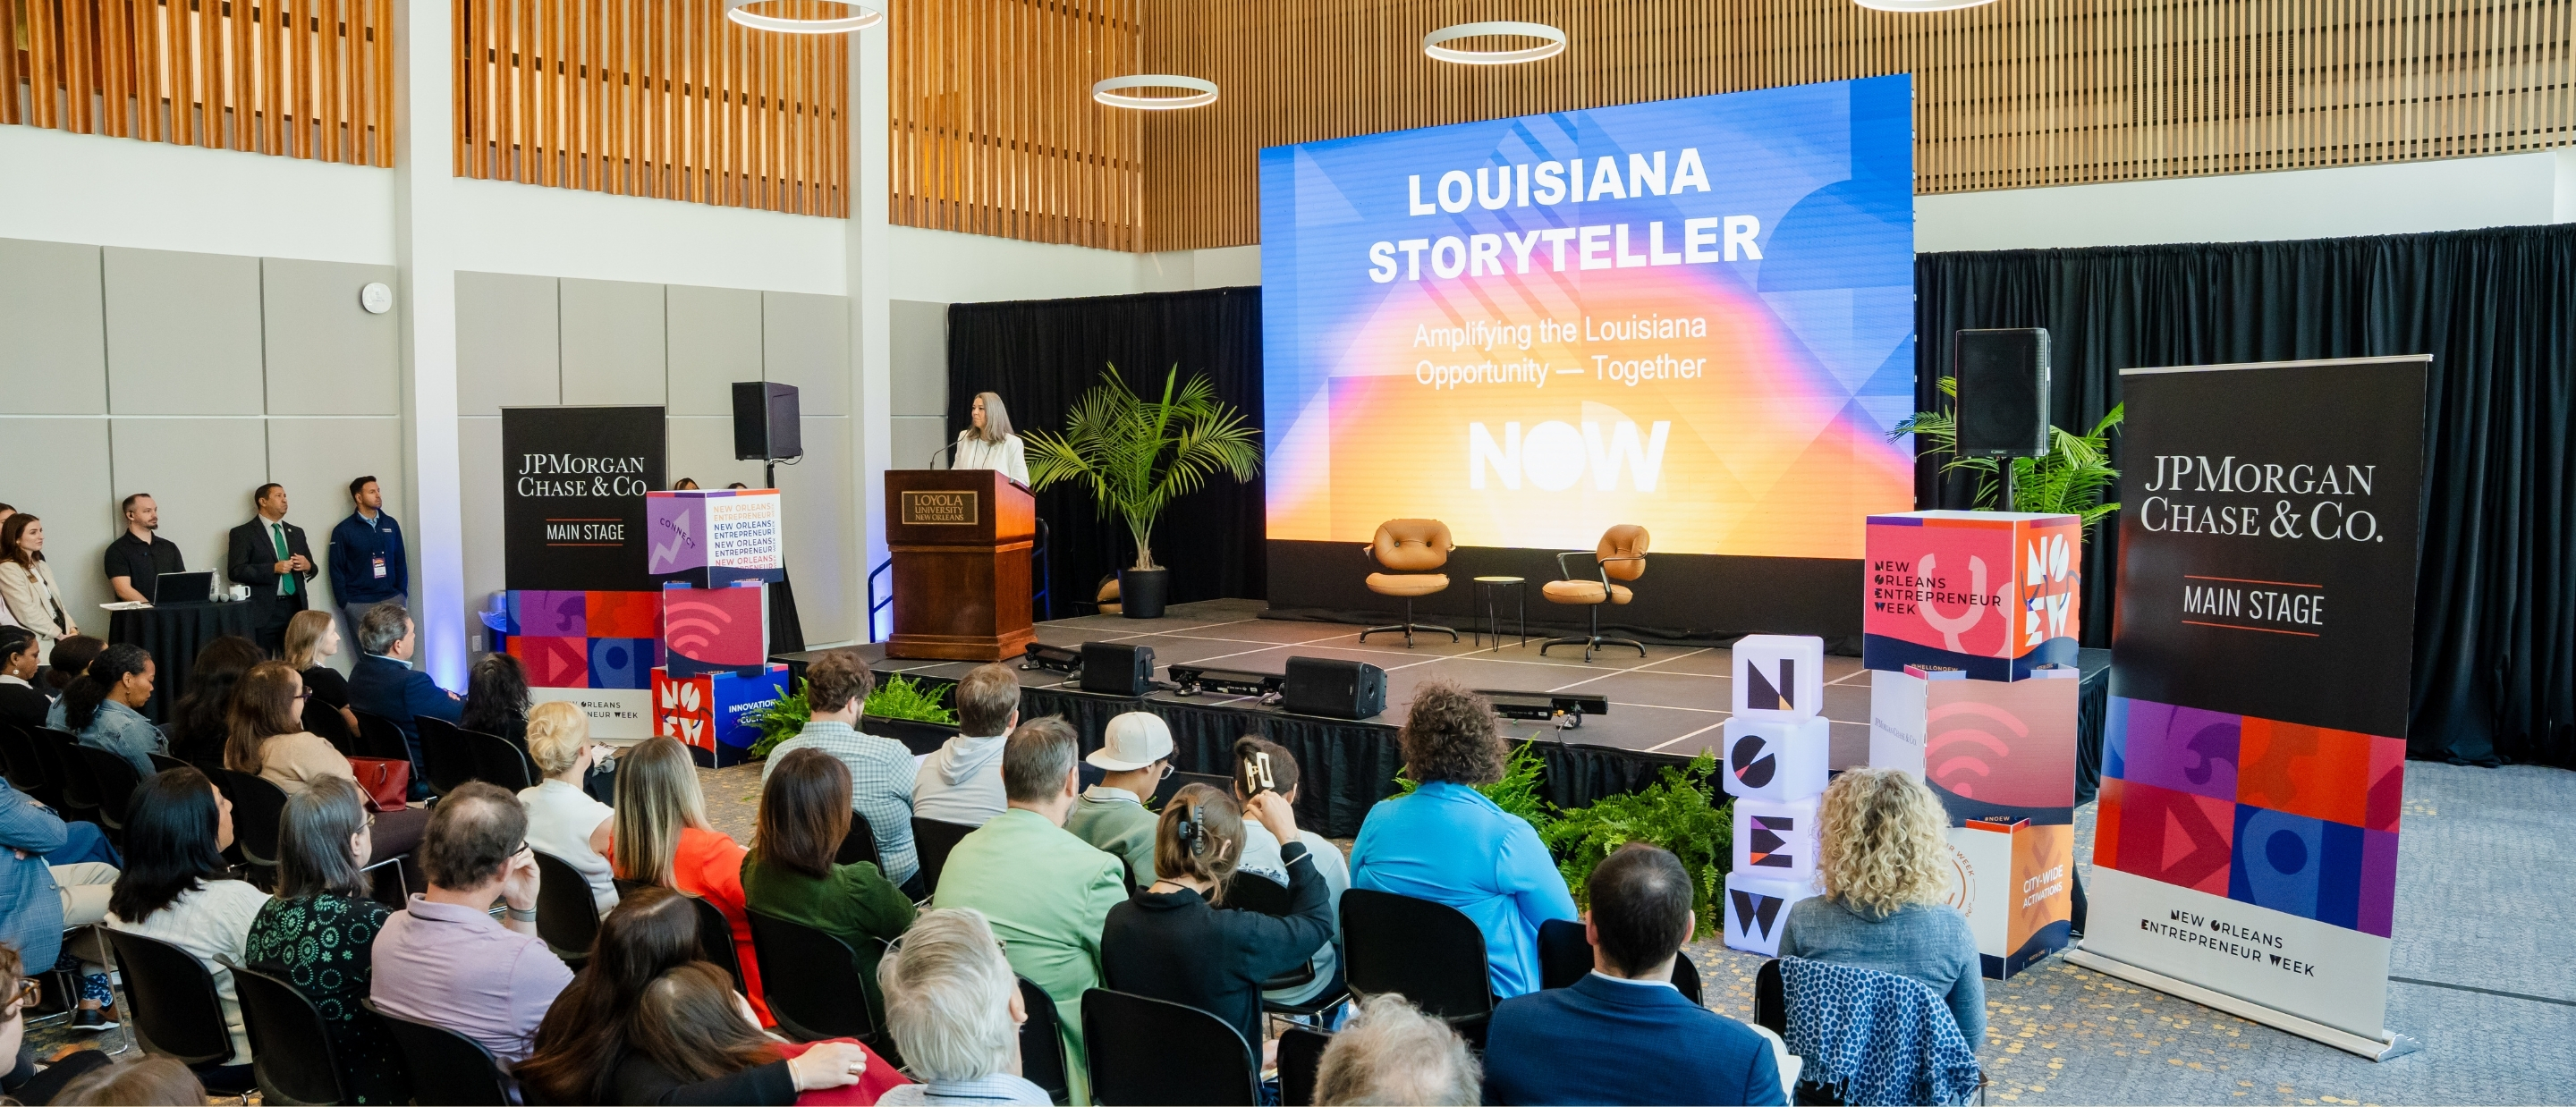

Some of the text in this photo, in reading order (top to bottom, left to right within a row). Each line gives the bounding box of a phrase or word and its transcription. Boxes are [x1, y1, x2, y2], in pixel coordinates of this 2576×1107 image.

[1408, 148, 1711, 217] LOUISIANA
[1368, 215, 1763, 284] STORYTELLER
[1413, 313, 1707, 352] Amplifying the Louisiana
[1416, 357, 1550, 390] Opportunity
[1590, 354, 1707, 388] Together
[519, 453, 645, 475] JPMORGAN
[1470, 419, 1671, 493] NOW
[2145, 455, 2376, 495] JPMORGAN
[517, 477, 588, 497] CHASE
[592, 476, 610, 497] &
[714, 503, 771, 513] NEW ORLEANS
[914, 494, 963, 506] LOYOLA
[714, 511, 771, 522] ENTREPRENEUR
[714, 520, 772, 531] NEW ORLEANS
[2140, 496, 2384, 543] CHASE & CO.
[547, 524, 624, 540] MAIN STAGE
[660, 518, 696, 549] CONNECT
[715, 529, 772, 540] ENTREPRENEUR
[716, 537, 773, 549] NEW ORLEANS
[716, 545, 773, 558] ENTREPRENEUR
[716, 554, 773, 567] NEW ORLEANS
[1875, 561, 1910, 572] NEW
[1875, 574, 1946, 588] ORLEANS
[1875, 588, 2002, 606] ENTREPRENEUR
[2183, 585, 2325, 626] MAIN STAGE
[1875, 602, 1916, 615] WEEK
[728, 699, 776, 714] INNOVATION
[1957, 851, 1975, 877] WEEK
[2023, 864, 2063, 893] CITY-WIDE
[2023, 882, 2063, 908] ACTIVATIONS
[2170, 908, 2283, 949] NEW ORLEANS
[2141, 918, 2315, 977] ENTREPRENEUR WEEK
